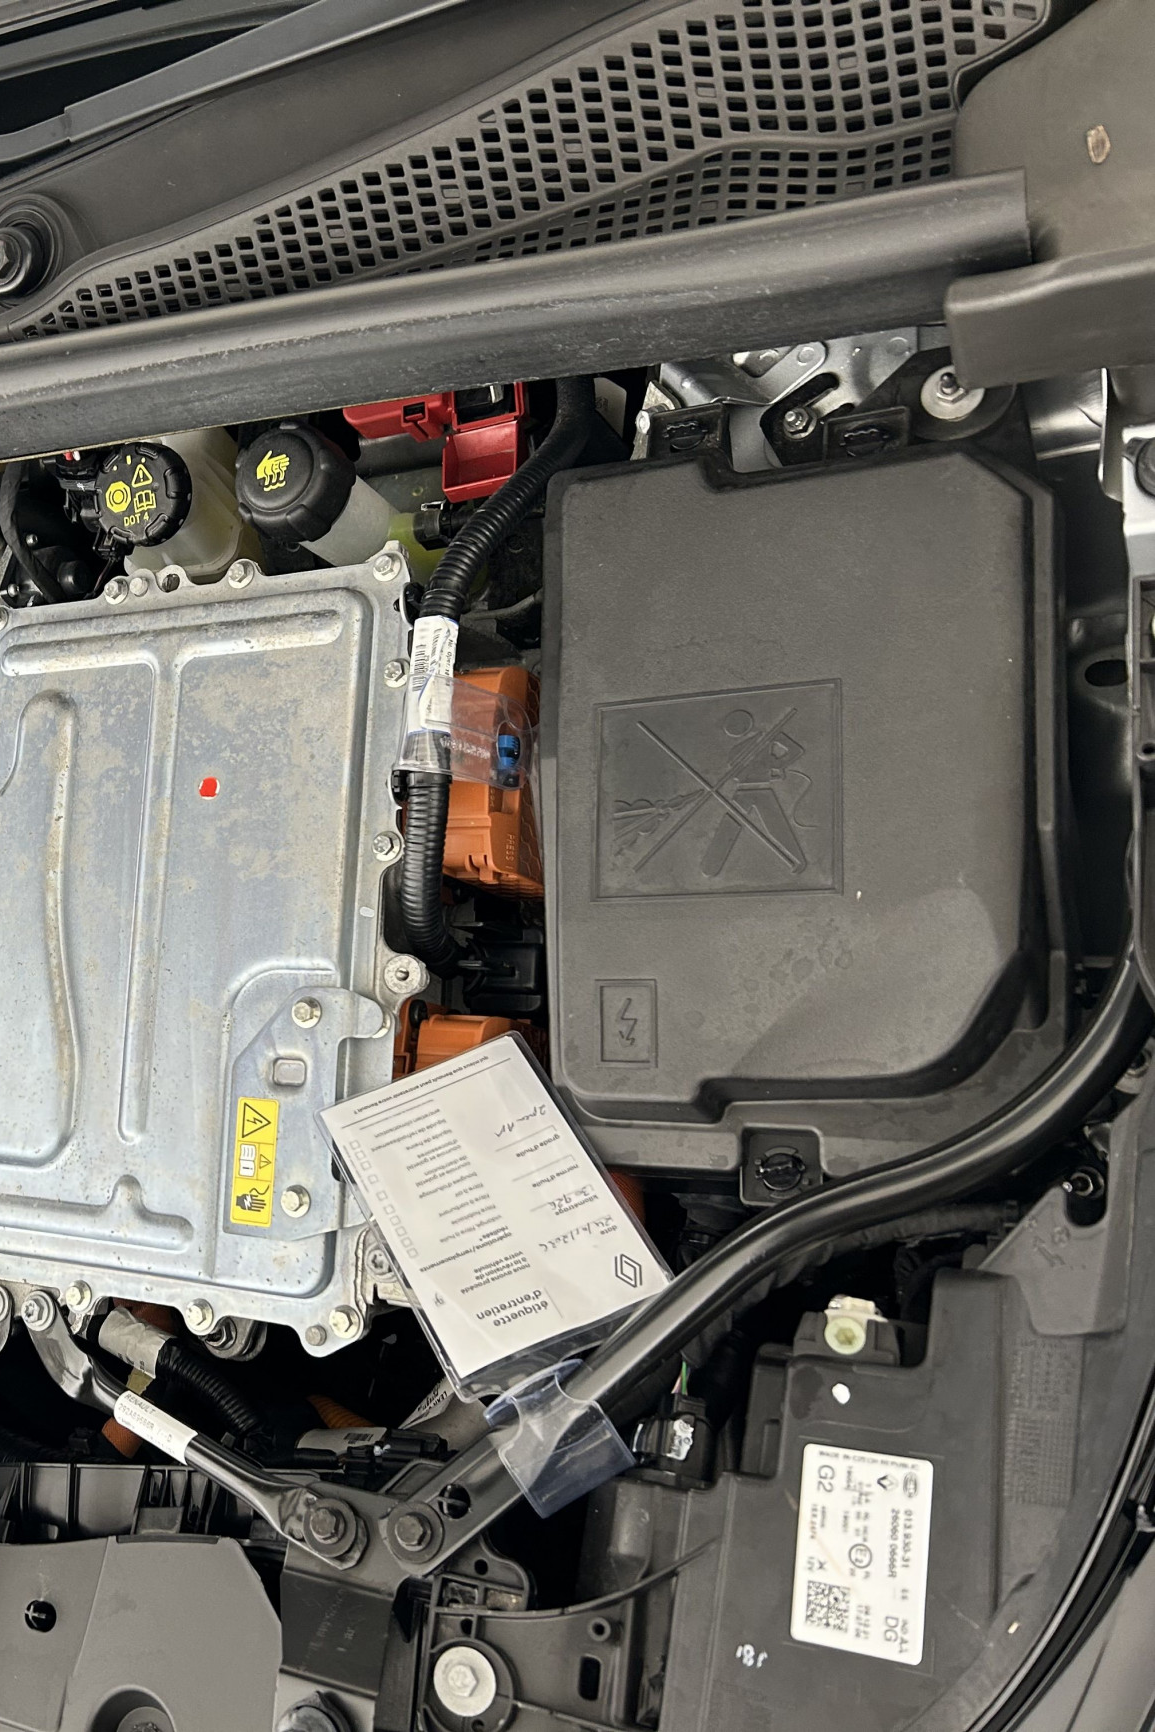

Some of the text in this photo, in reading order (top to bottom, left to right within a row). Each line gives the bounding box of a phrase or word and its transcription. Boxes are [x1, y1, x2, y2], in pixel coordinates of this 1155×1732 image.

[123, 511, 149, 527] DOT 4
[599, 1224, 618, 1236] date
[475, 1287, 542, 1323] d'entretien
[491, 1297, 549, 1330] étiquette
[816, 1463, 835, 1493] G2
[883, 1615, 899, 1642] DG
